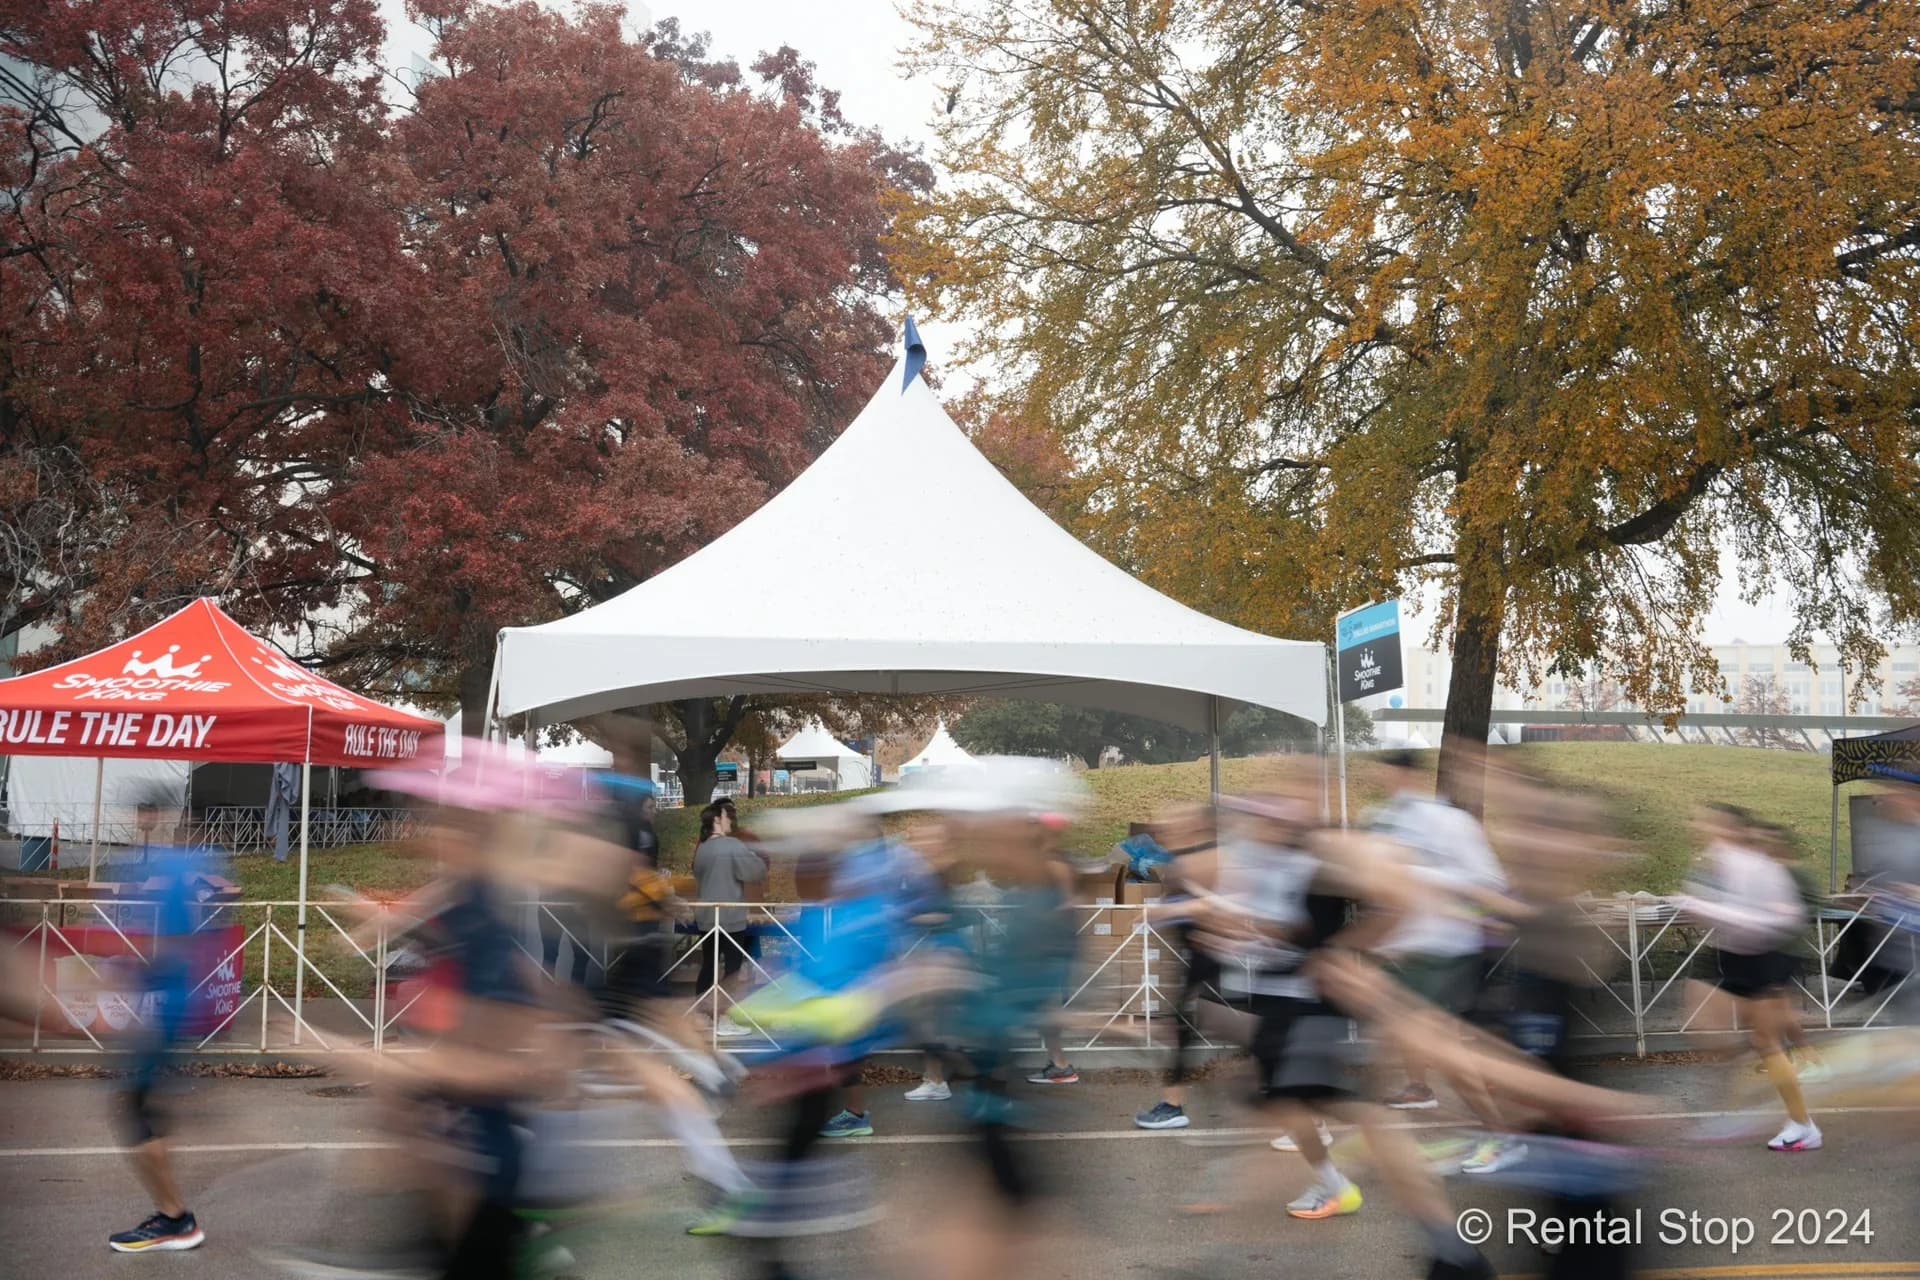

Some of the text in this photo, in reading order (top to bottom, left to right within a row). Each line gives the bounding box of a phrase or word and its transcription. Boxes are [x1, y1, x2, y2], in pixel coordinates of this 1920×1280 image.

[53, 673, 232, 693] SMOOTHIE
[74, 687, 168, 701] KING
[79, 711, 142, 746] THE
[343, 723, 421, 759] RULE THE DAY
[206, 981, 241, 999] SMOOTHIE
[214, 998, 233, 1015] KING
